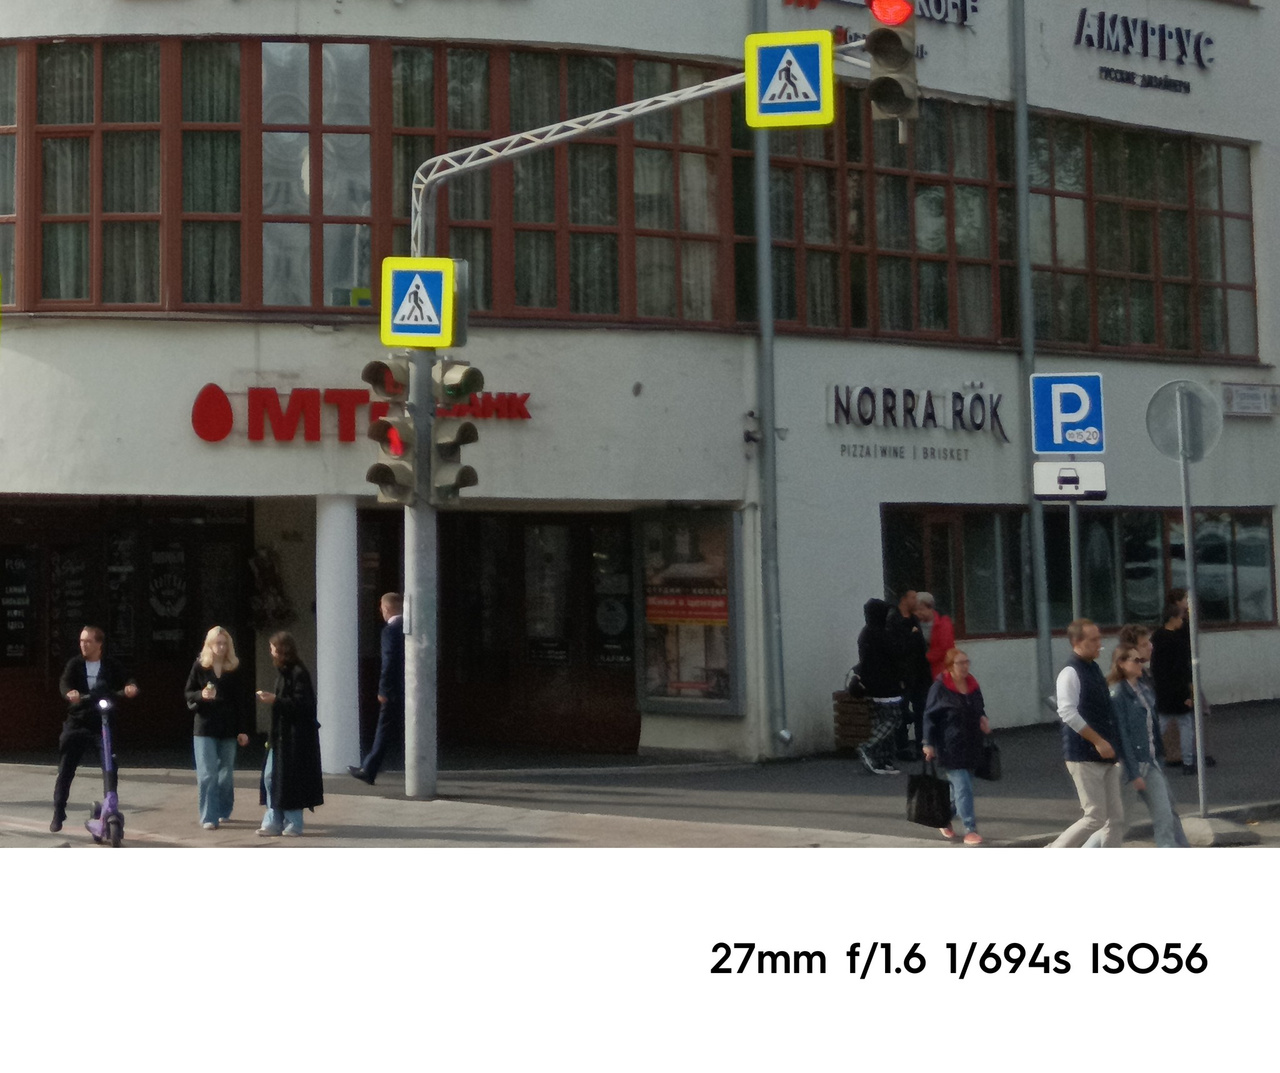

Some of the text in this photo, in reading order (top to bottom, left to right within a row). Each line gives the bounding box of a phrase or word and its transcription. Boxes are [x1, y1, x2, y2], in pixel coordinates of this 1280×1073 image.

[828, 381, 1011, 444] NORRA RÖK
[1051, 383, 1090, 445] P
[840, 443, 970, 462] PIZZA WINE BRISKET
[1085, 431, 1099, 441] 20
